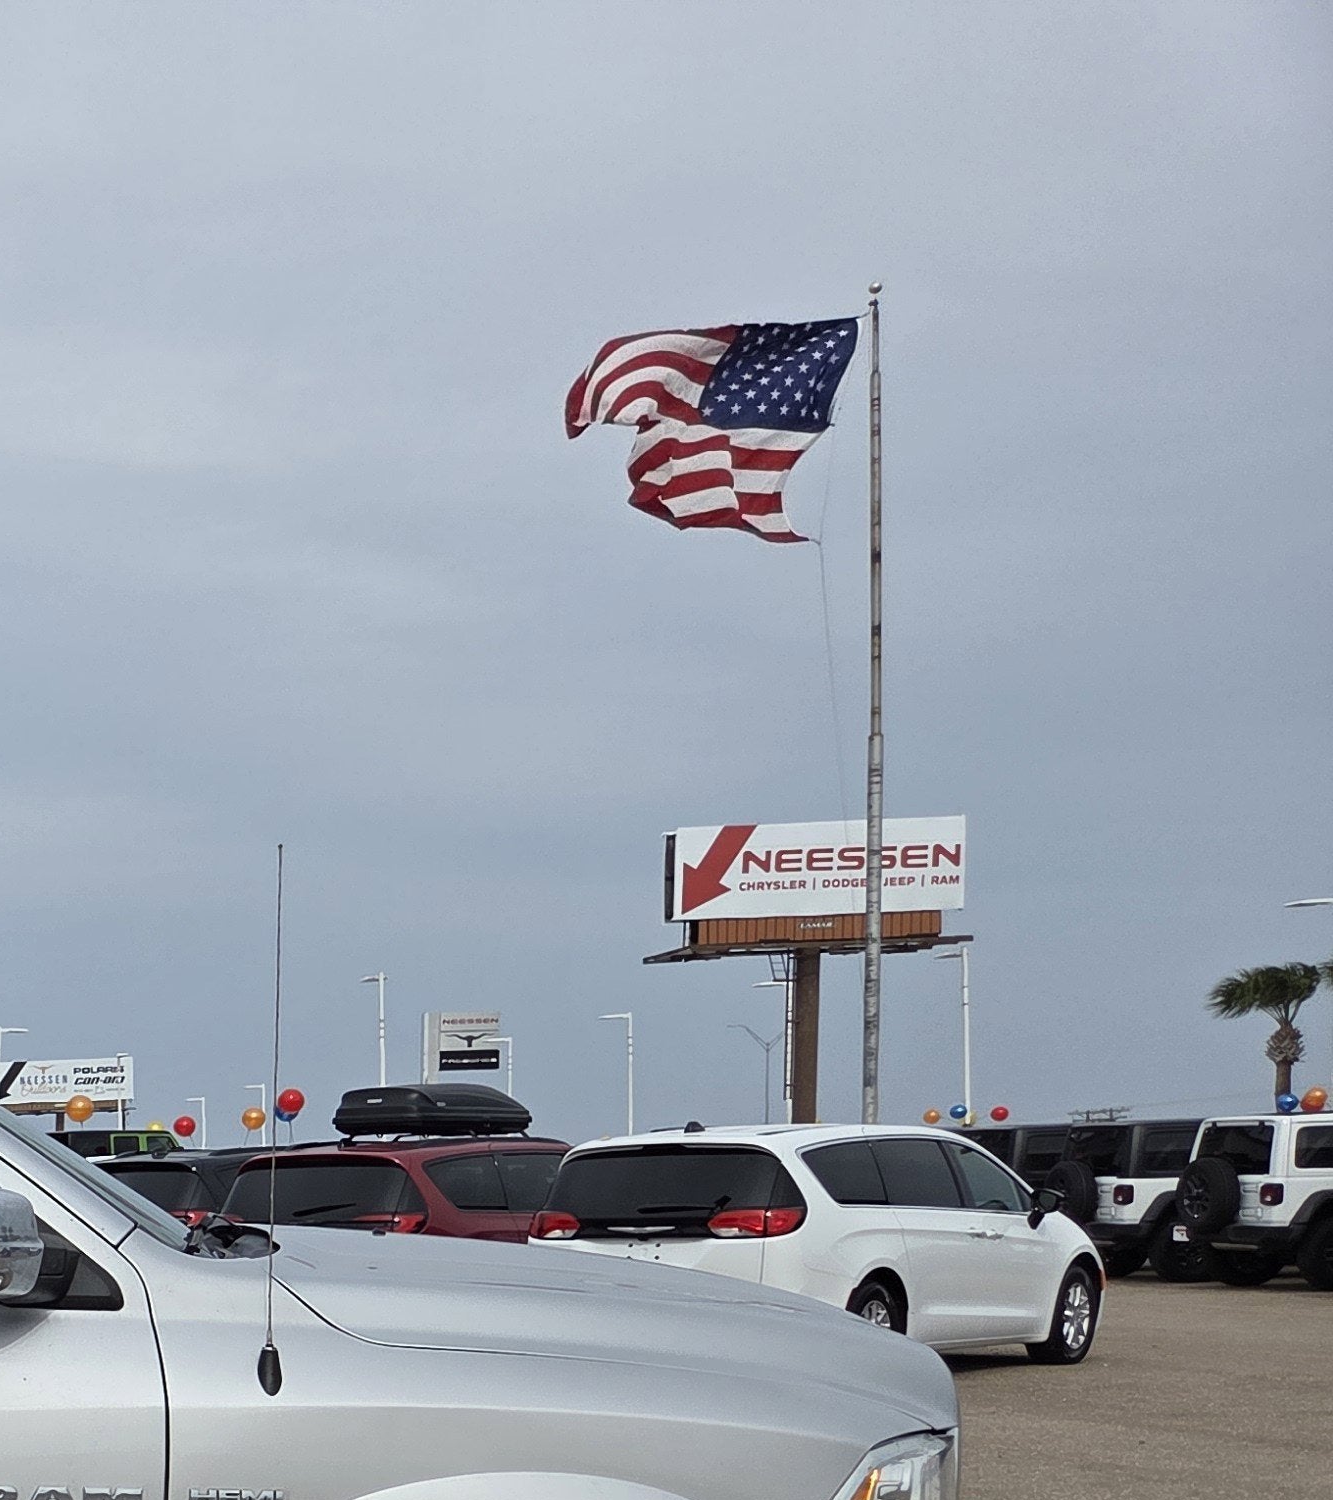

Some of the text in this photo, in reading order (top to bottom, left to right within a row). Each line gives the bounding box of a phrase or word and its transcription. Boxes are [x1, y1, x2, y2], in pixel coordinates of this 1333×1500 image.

[741, 843, 961, 874] NEESSEN
[738, 875, 960, 892] CHRYSLER DODGE JEEP RAM
[19, 1074, 68, 1086] NEESSEN
